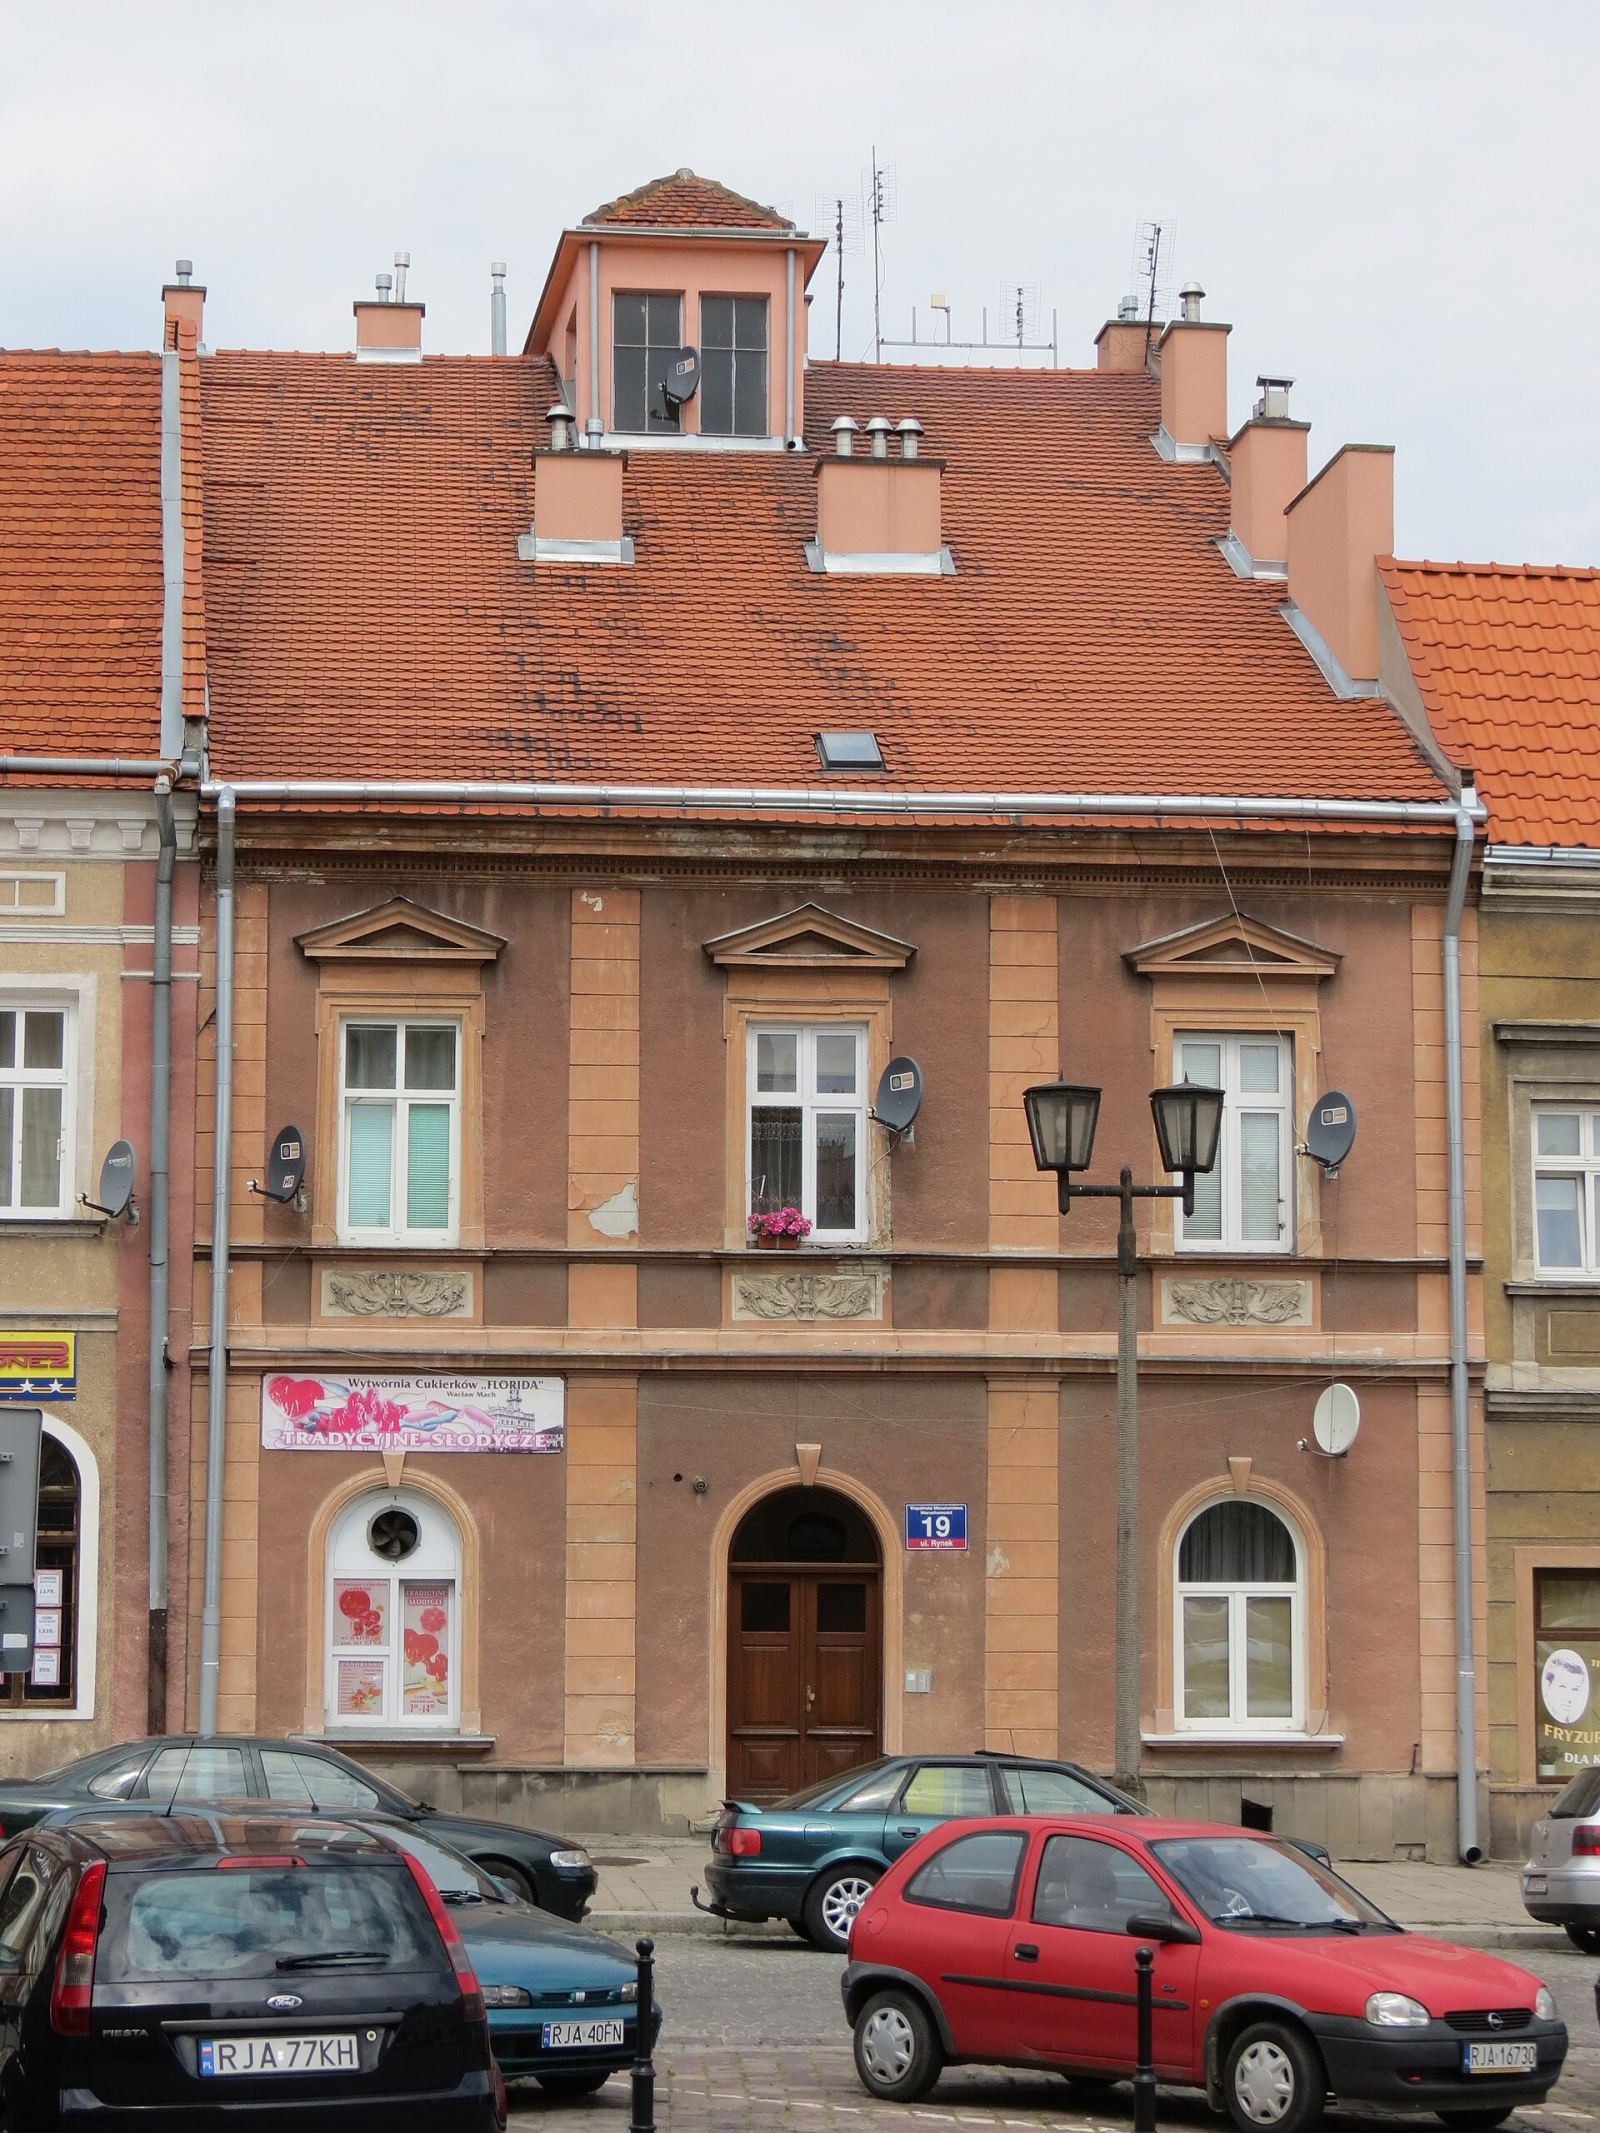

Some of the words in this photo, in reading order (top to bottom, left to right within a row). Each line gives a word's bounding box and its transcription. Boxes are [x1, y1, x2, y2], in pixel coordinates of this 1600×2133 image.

[348, 1378, 411, 1390] Wytwórnia
[415, 1379, 478, 1390] Cukierków
[283, 1431, 421, 1447] TRADYCYJNE
[431, 1433, 548, 1448] SŁODYCZE
[921, 1516, 951, 1537] 19
[931, 1540, 954, 1548] Rynek
[1564, 1752, 1589, 1764] DLA
[102, 2028, 149, 2037] FIESTA
[202, 2061, 212, 2069] PL
